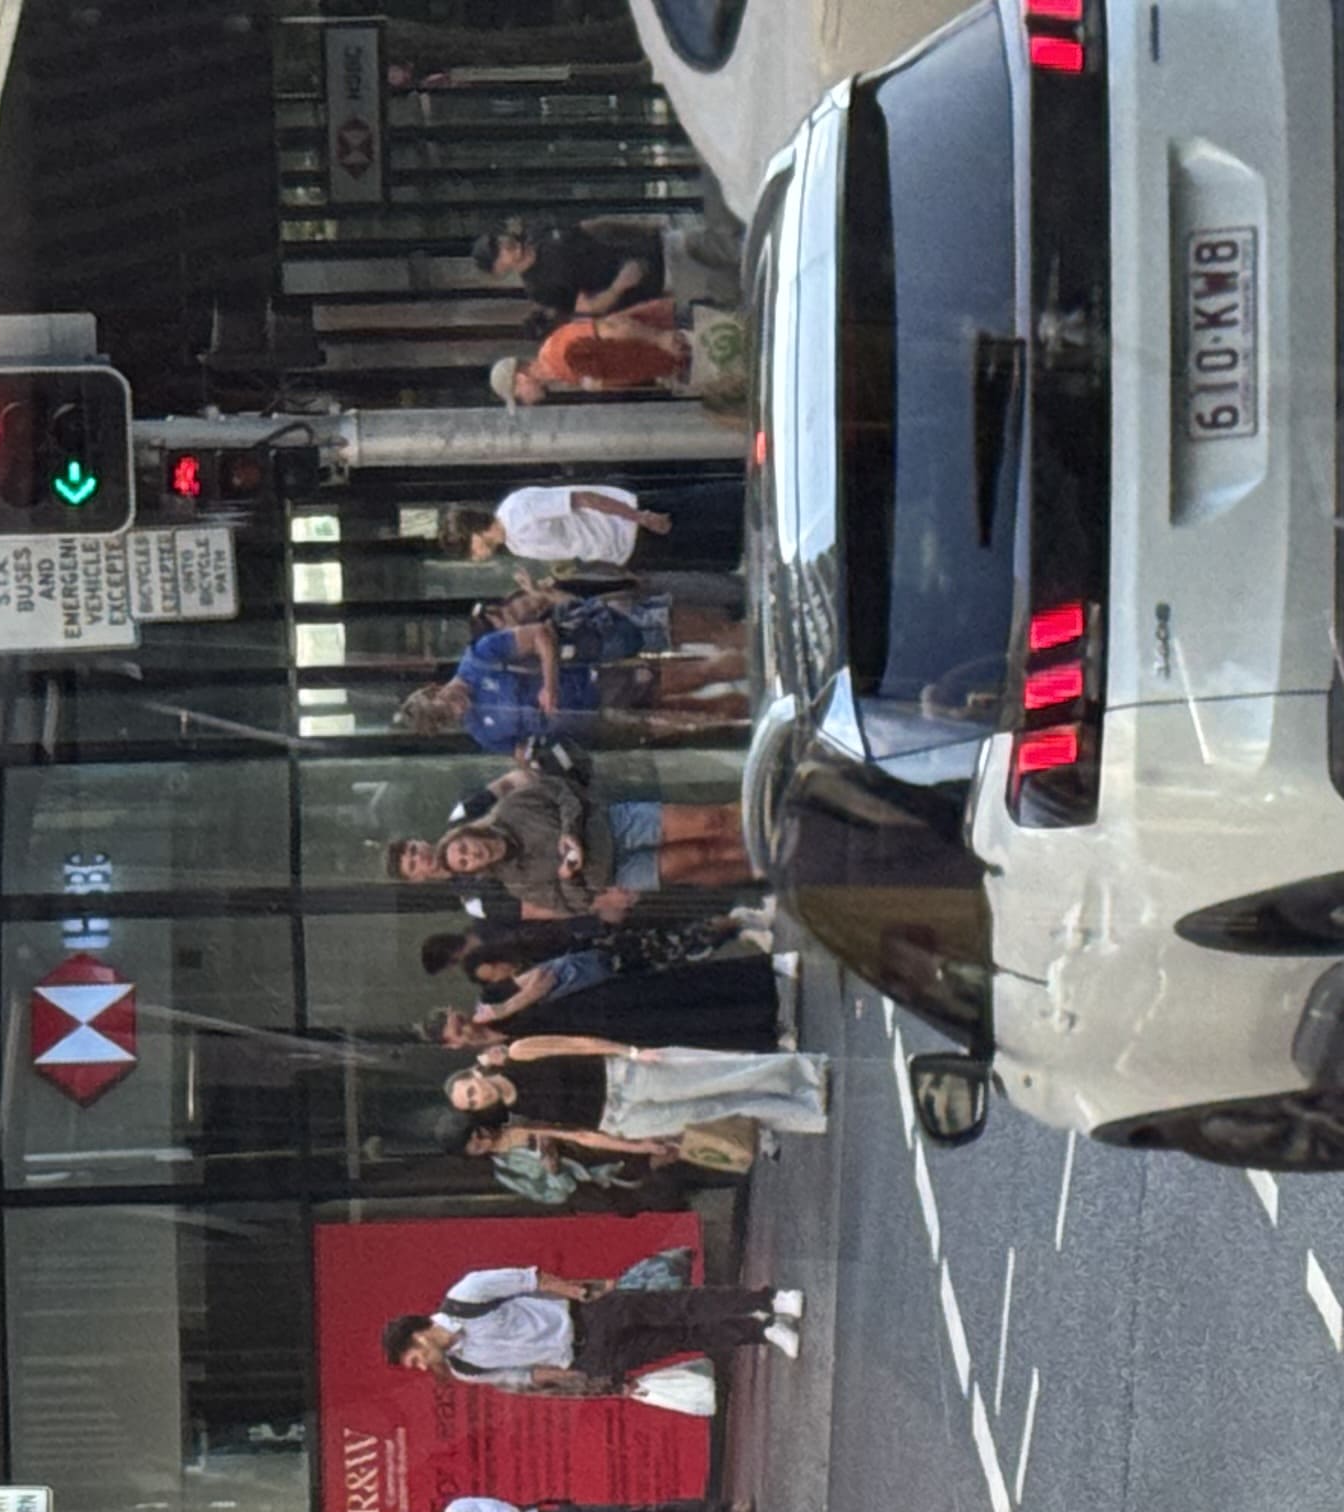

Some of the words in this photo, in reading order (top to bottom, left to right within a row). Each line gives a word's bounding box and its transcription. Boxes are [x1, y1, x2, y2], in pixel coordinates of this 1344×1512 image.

[12, 546, 35, 613] BUSES
[36, 558, 56, 601] AND
[59, 537, 82, 639] EMERGEN
[82, 537, 103, 625] VEHICLE
[104, 538, 126, 626] EXCEPTE
[133, 536, 153, 614] BICYCLES
[181, 549, 196, 594] ONTO
[196, 538, 214, 606] BICYCLE
[214, 549, 227, 594] PATH
[61, 852, 110, 941] HBC
